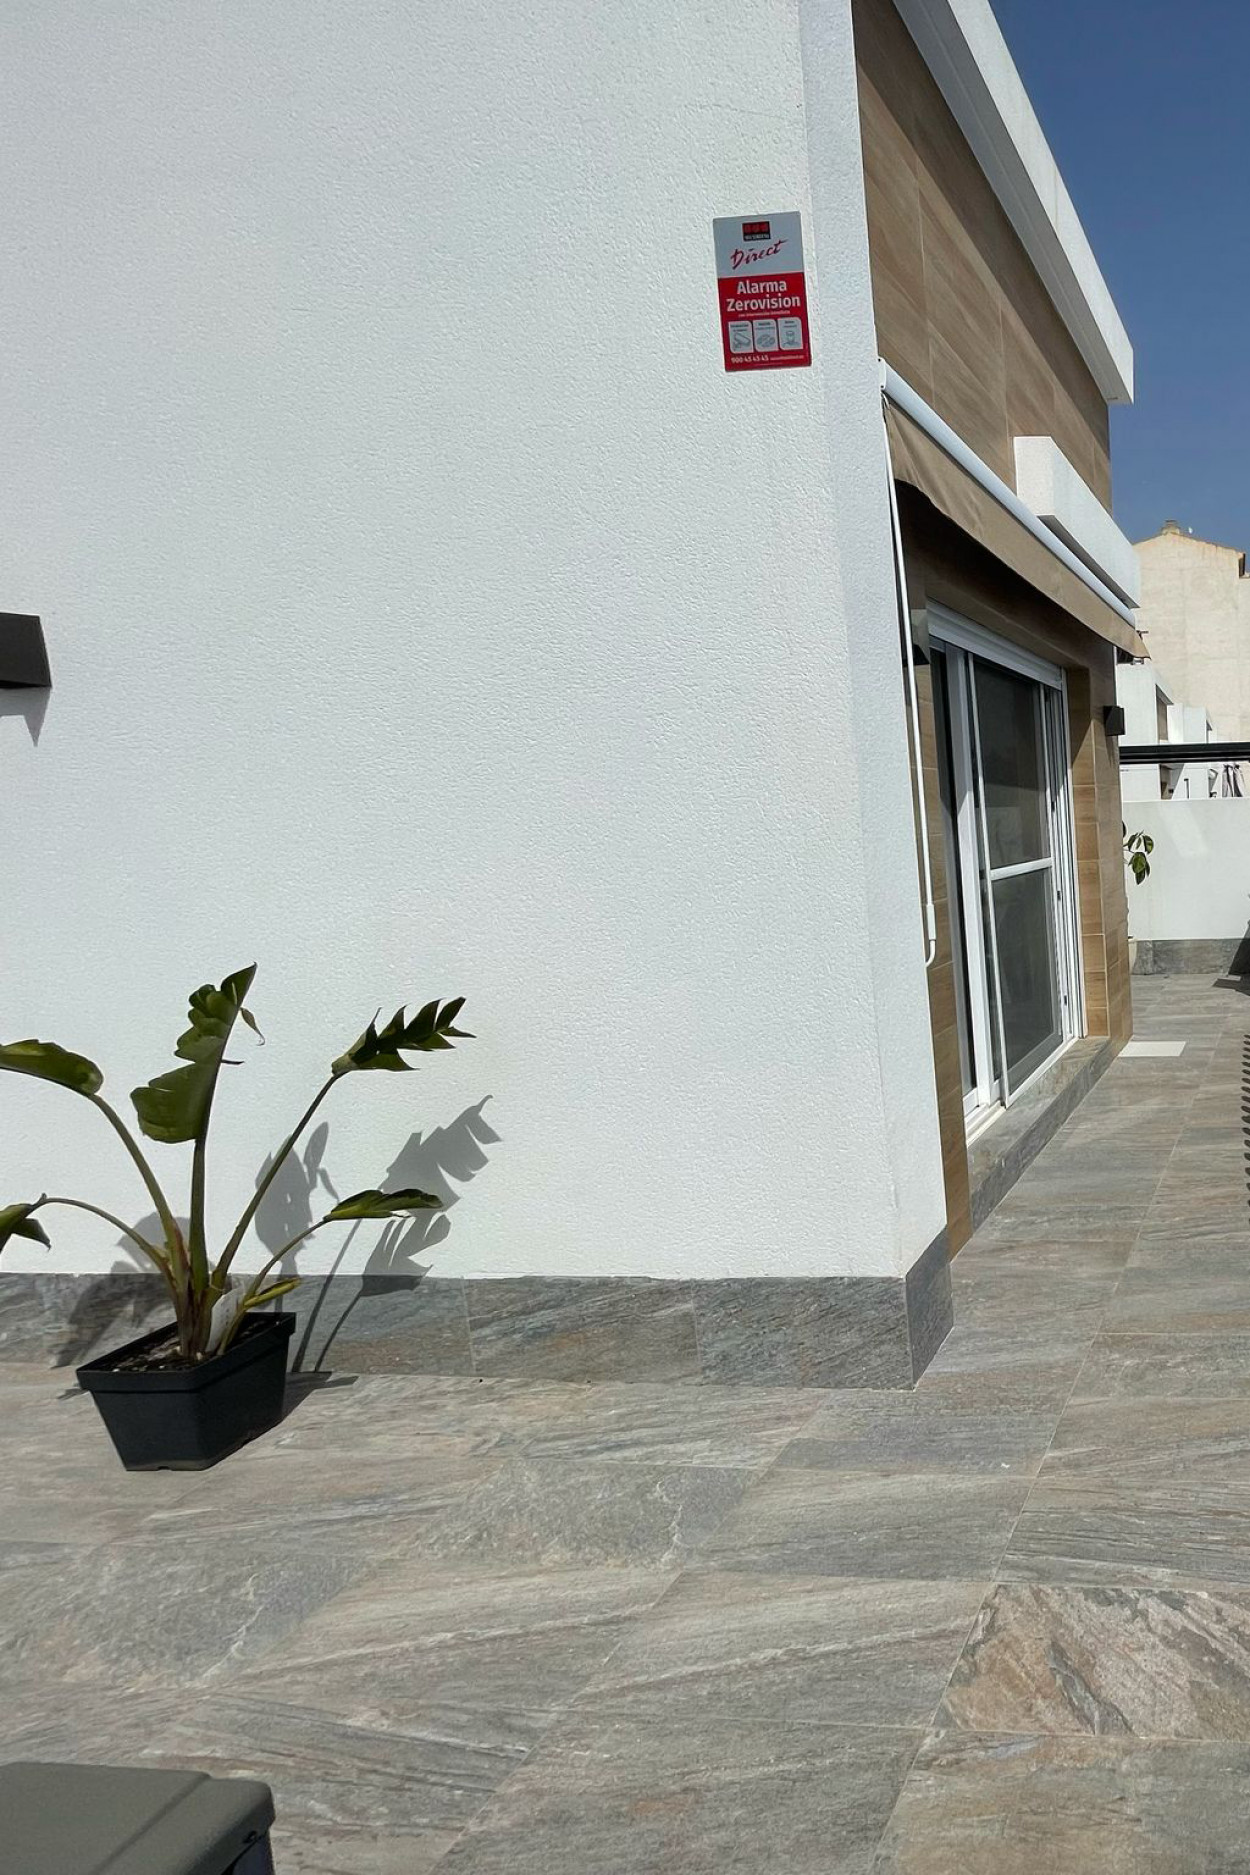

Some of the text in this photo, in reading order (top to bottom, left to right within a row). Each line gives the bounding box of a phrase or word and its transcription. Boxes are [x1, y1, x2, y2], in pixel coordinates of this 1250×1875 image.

[730, 239, 788, 270] Direct
[737, 280, 787, 294] Alarma
[726, 293, 801, 312] Zerovision
